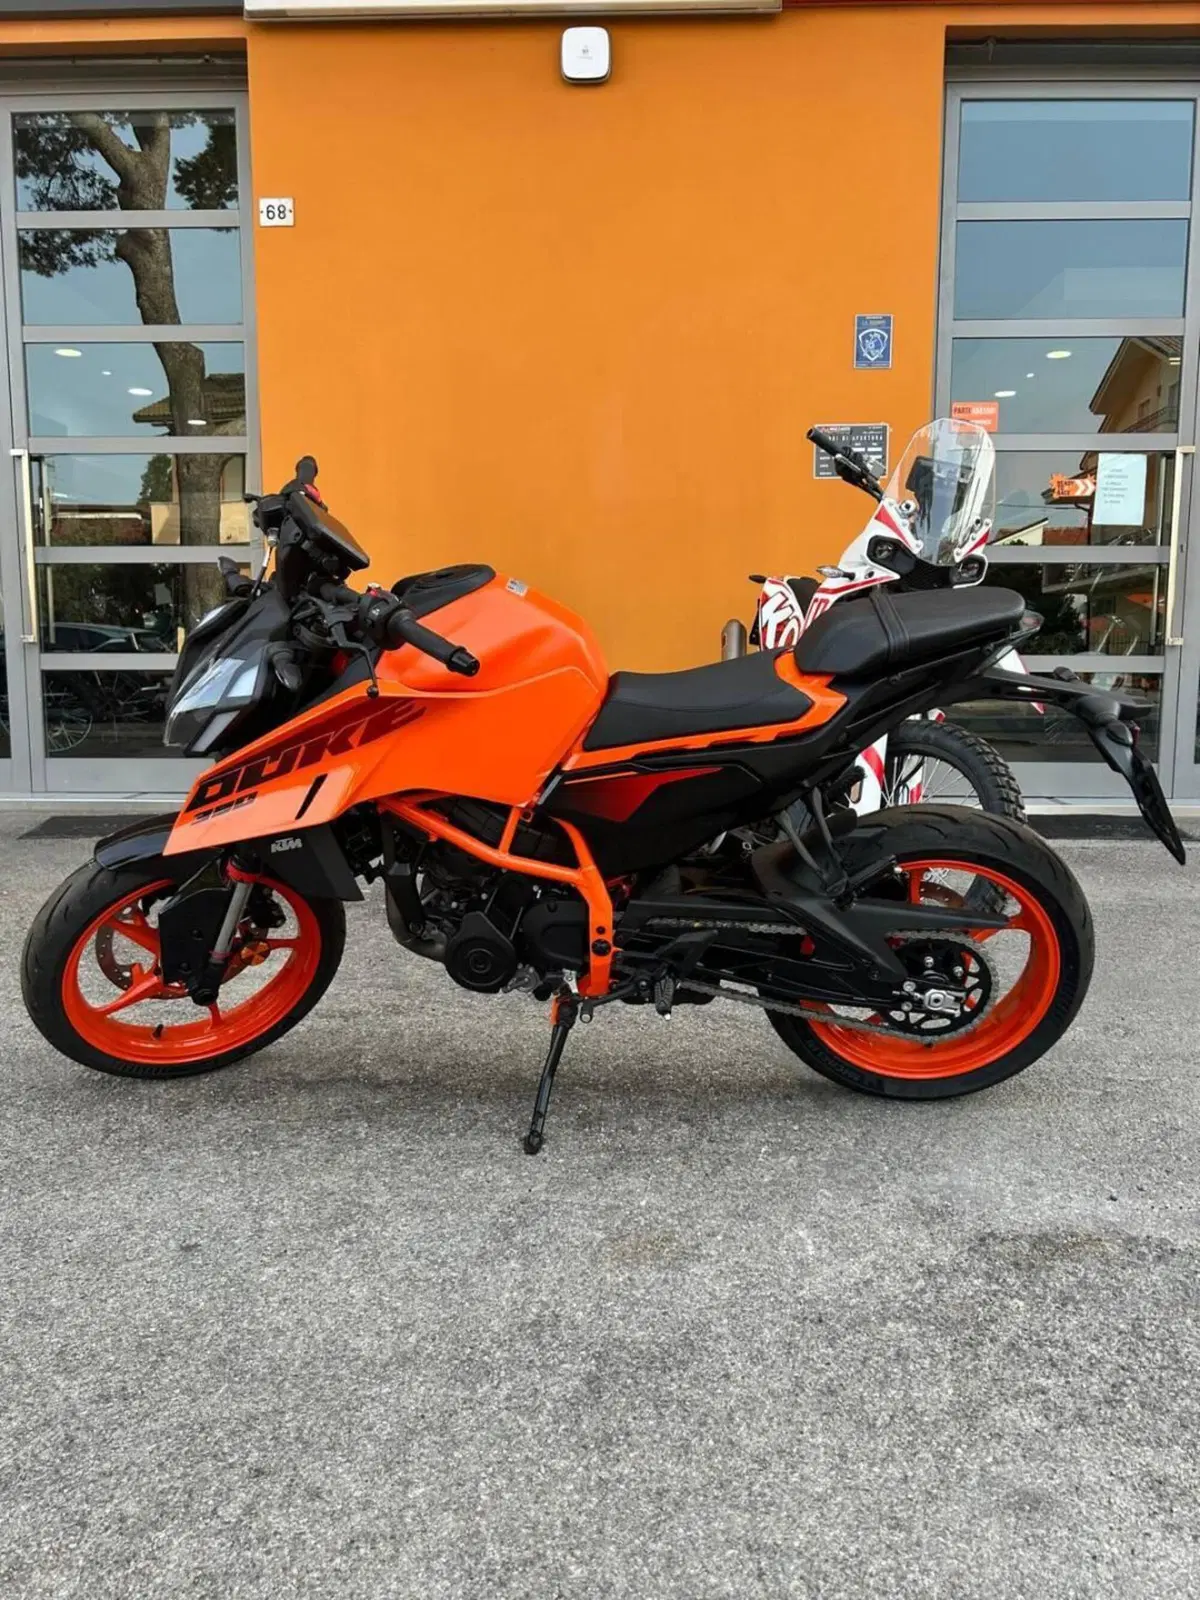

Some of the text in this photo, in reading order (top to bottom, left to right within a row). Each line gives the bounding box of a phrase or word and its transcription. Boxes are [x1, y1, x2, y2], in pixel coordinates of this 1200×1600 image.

[266, 204, 287, 220] 68
[184, 700, 428, 814] DUKE
[270, 837, 303, 854] KTM
